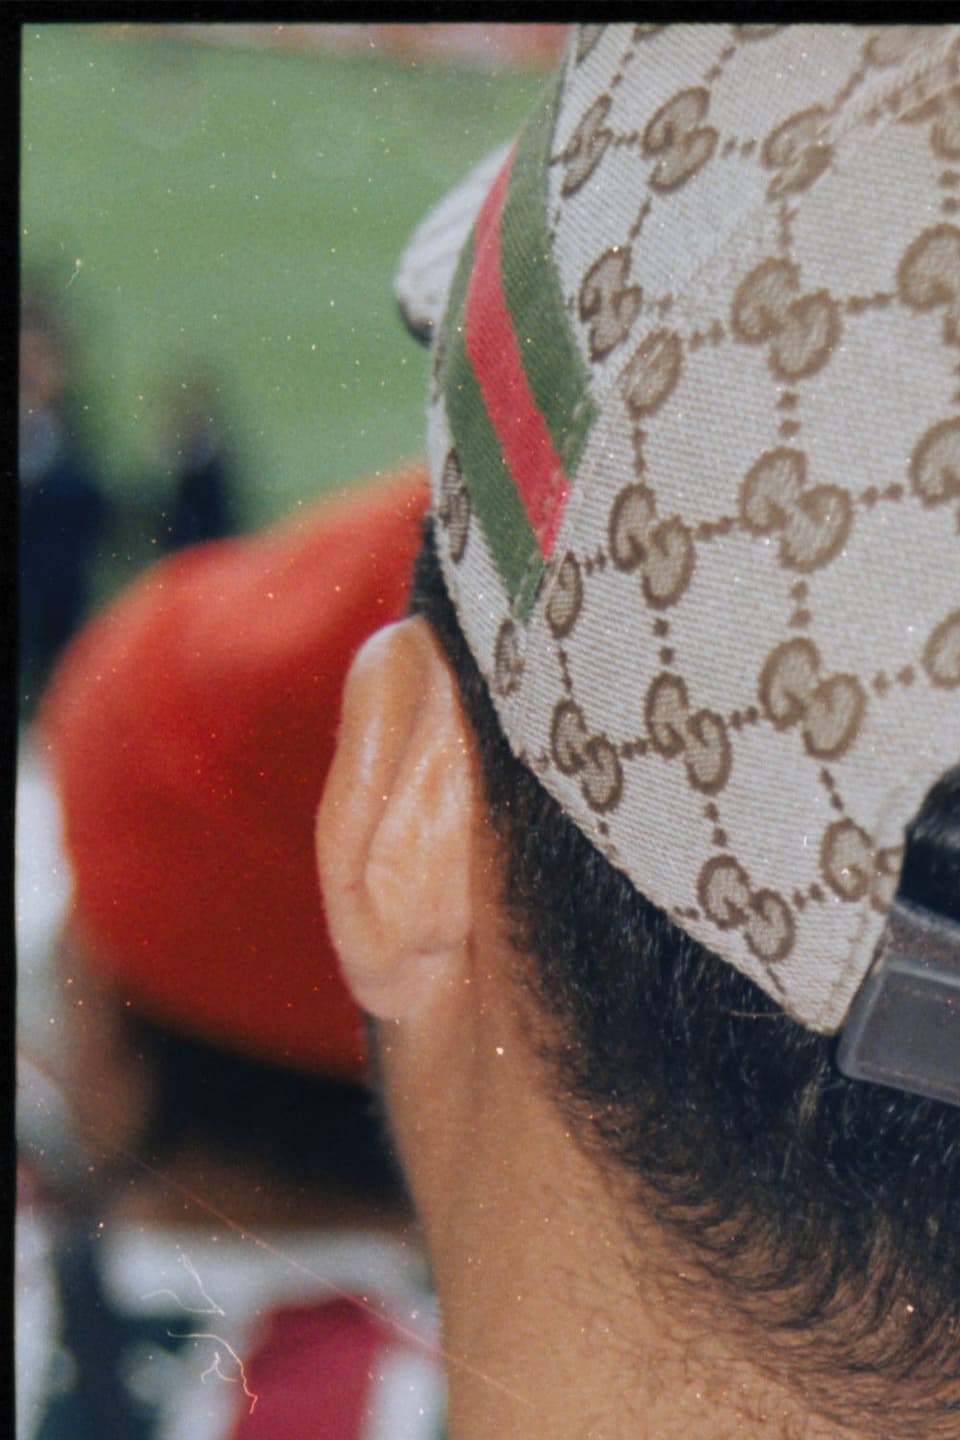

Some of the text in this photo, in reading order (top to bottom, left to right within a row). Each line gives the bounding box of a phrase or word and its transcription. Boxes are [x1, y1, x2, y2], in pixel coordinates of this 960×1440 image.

[642, 86, 717, 193] GG
[578, 246, 641, 361] GG
[732, 258, 839, 380] GG
[609, 483, 695, 608] GG
[739, 447, 853, 572] GG
[550, 700, 623, 813] GG
[646, 673, 731, 795] GG
[758, 637, 866, 759] GG
[698, 854, 795, 962] GG
